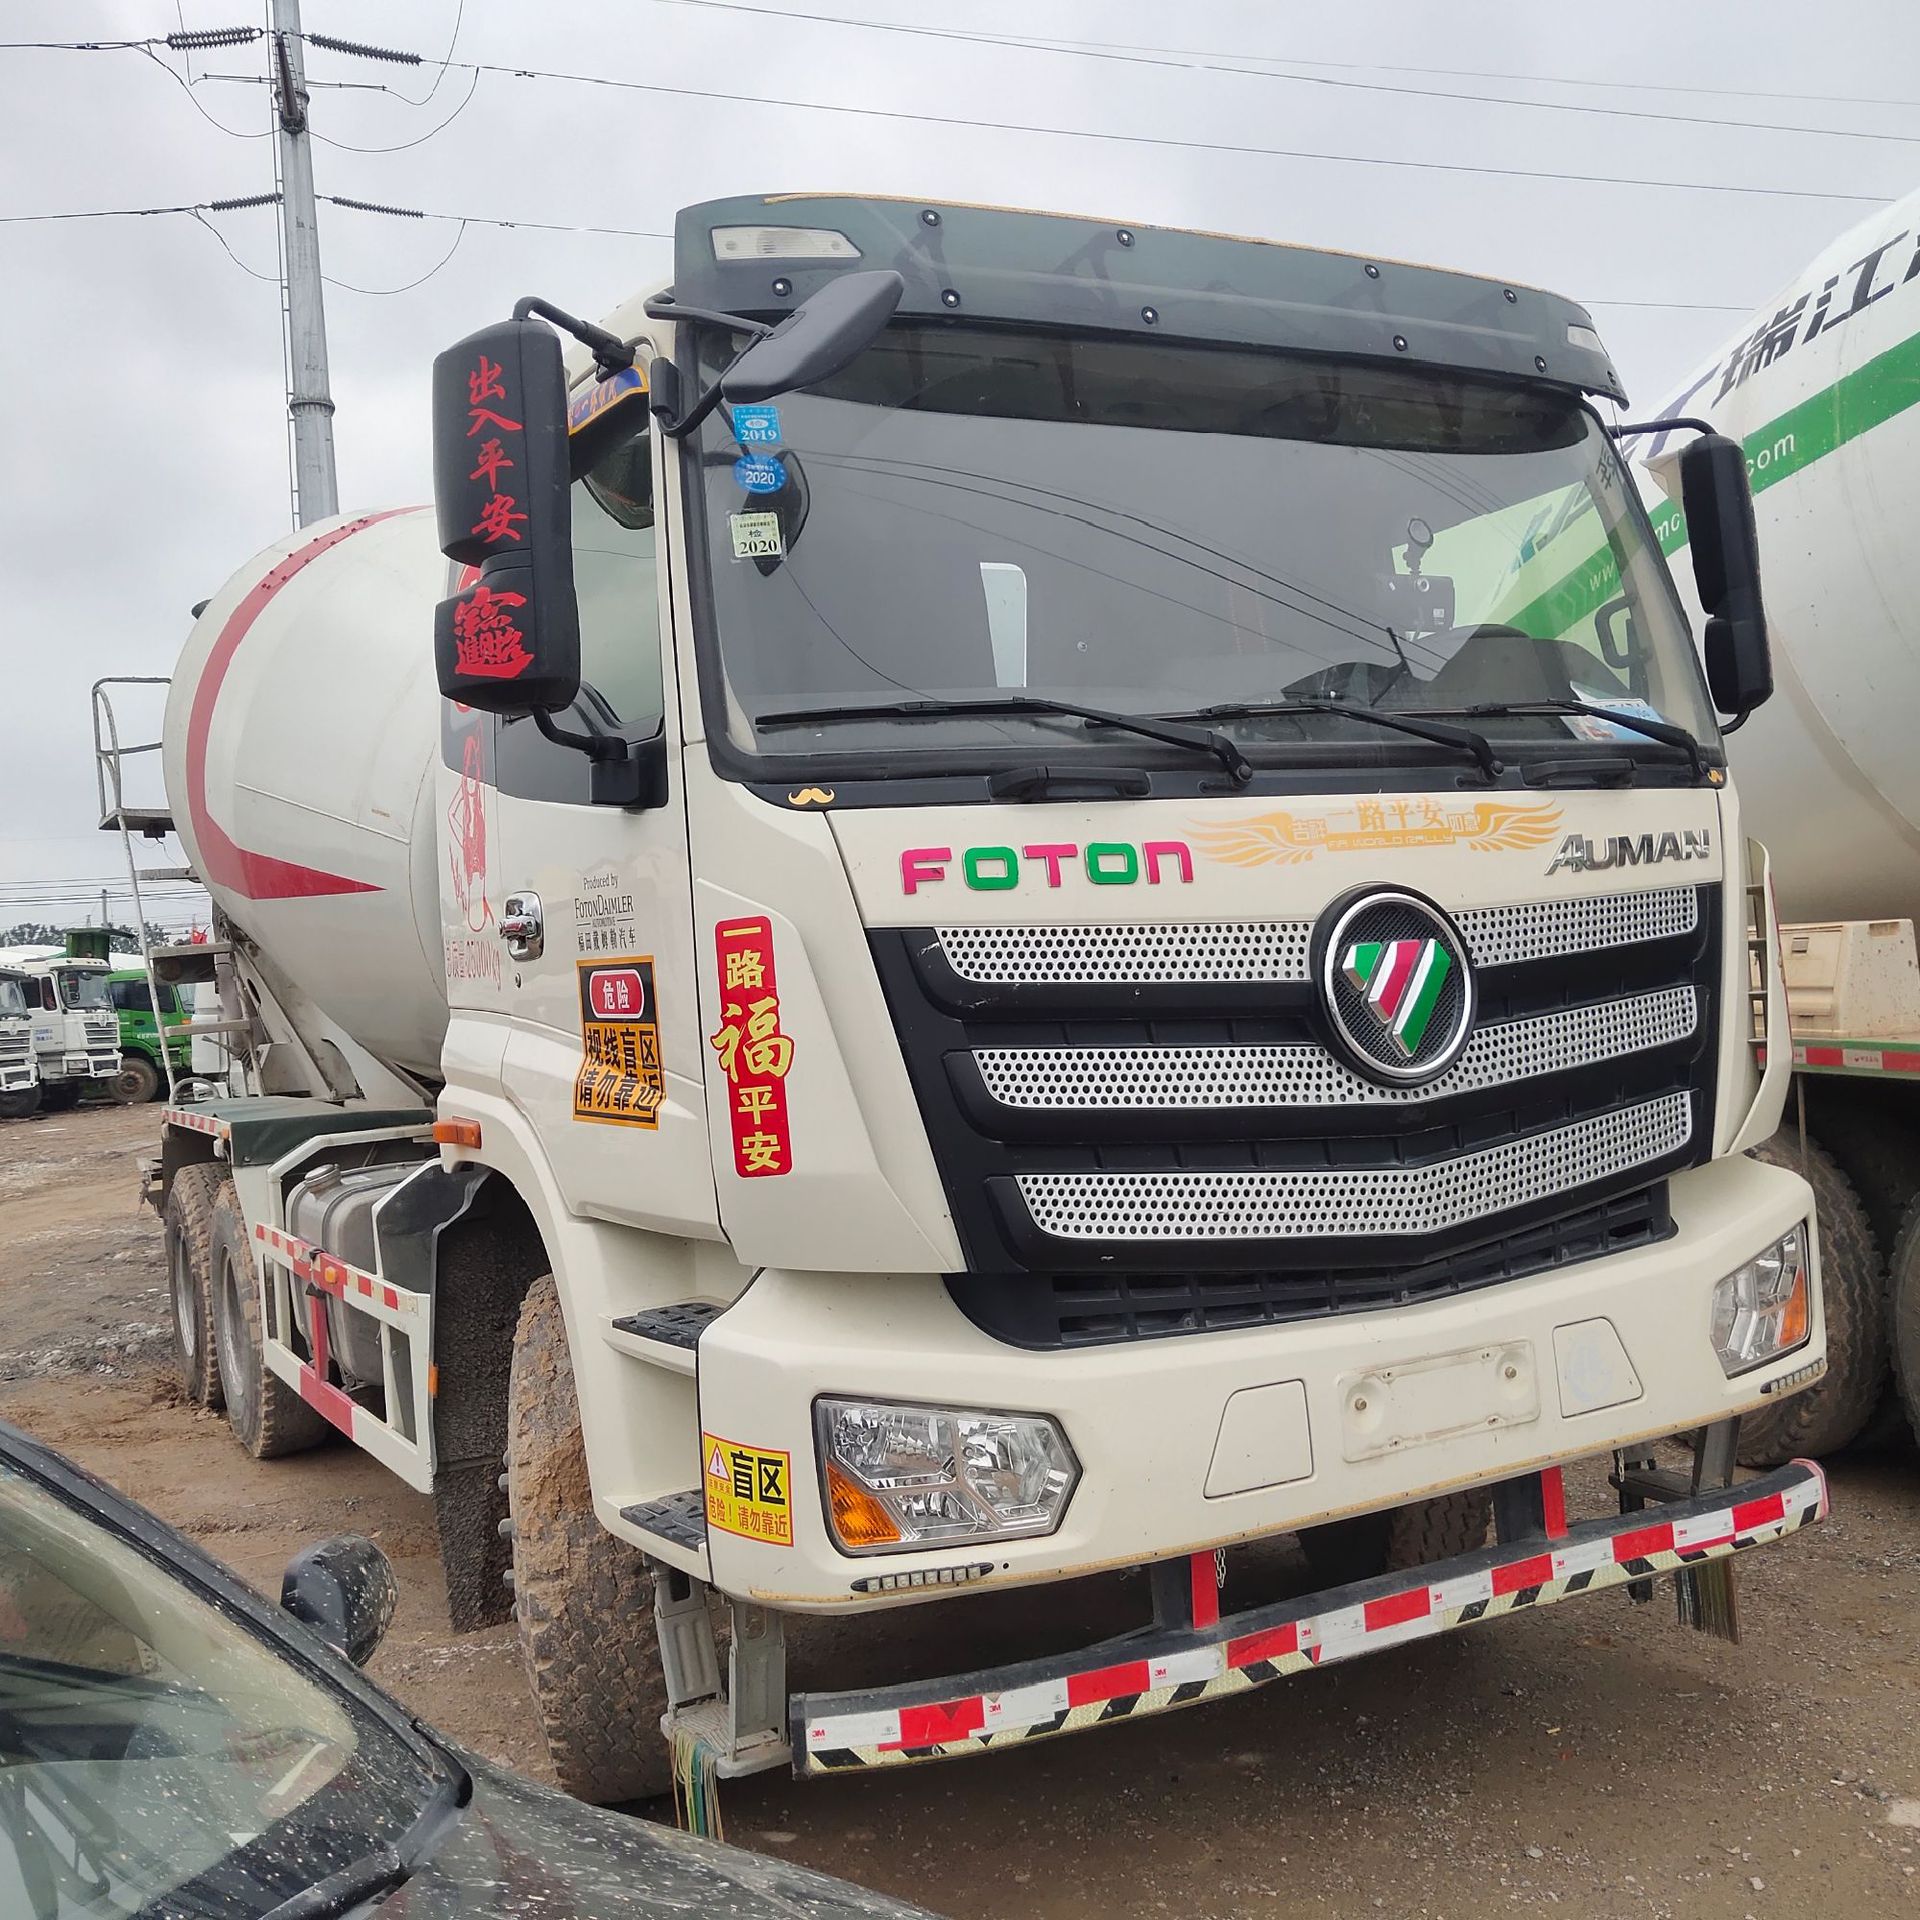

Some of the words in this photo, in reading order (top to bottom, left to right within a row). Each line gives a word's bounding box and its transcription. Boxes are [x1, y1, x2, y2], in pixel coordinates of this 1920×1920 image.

[1710, 229, 1920, 410] 瑞江
[467, 355, 529, 541] 出入平安
[740, 430, 777, 440] 2019
[745, 471, 775, 485] 2020
[739, 539, 777, 555] 2020
[1327, 797, 1445, 831] 一路平安
[899, 840, 1194, 895] FOTON
[1544, 829, 1710, 876] AUMAN
[583, 875, 610, 891] Produced
[610, 874, 619, 889] by
[603, 979, 630, 1010] 危险
[587, 1028, 658, 1070] 视线盲区
[579, 1068, 660, 1112] 请勿靠近
[730, 1450, 786, 1505] 盲区
[1155, 1668, 1167, 1677] 3M
[989, 1703, 1001, 1713] 3M
[812, 1729, 826, 1738] 3M
